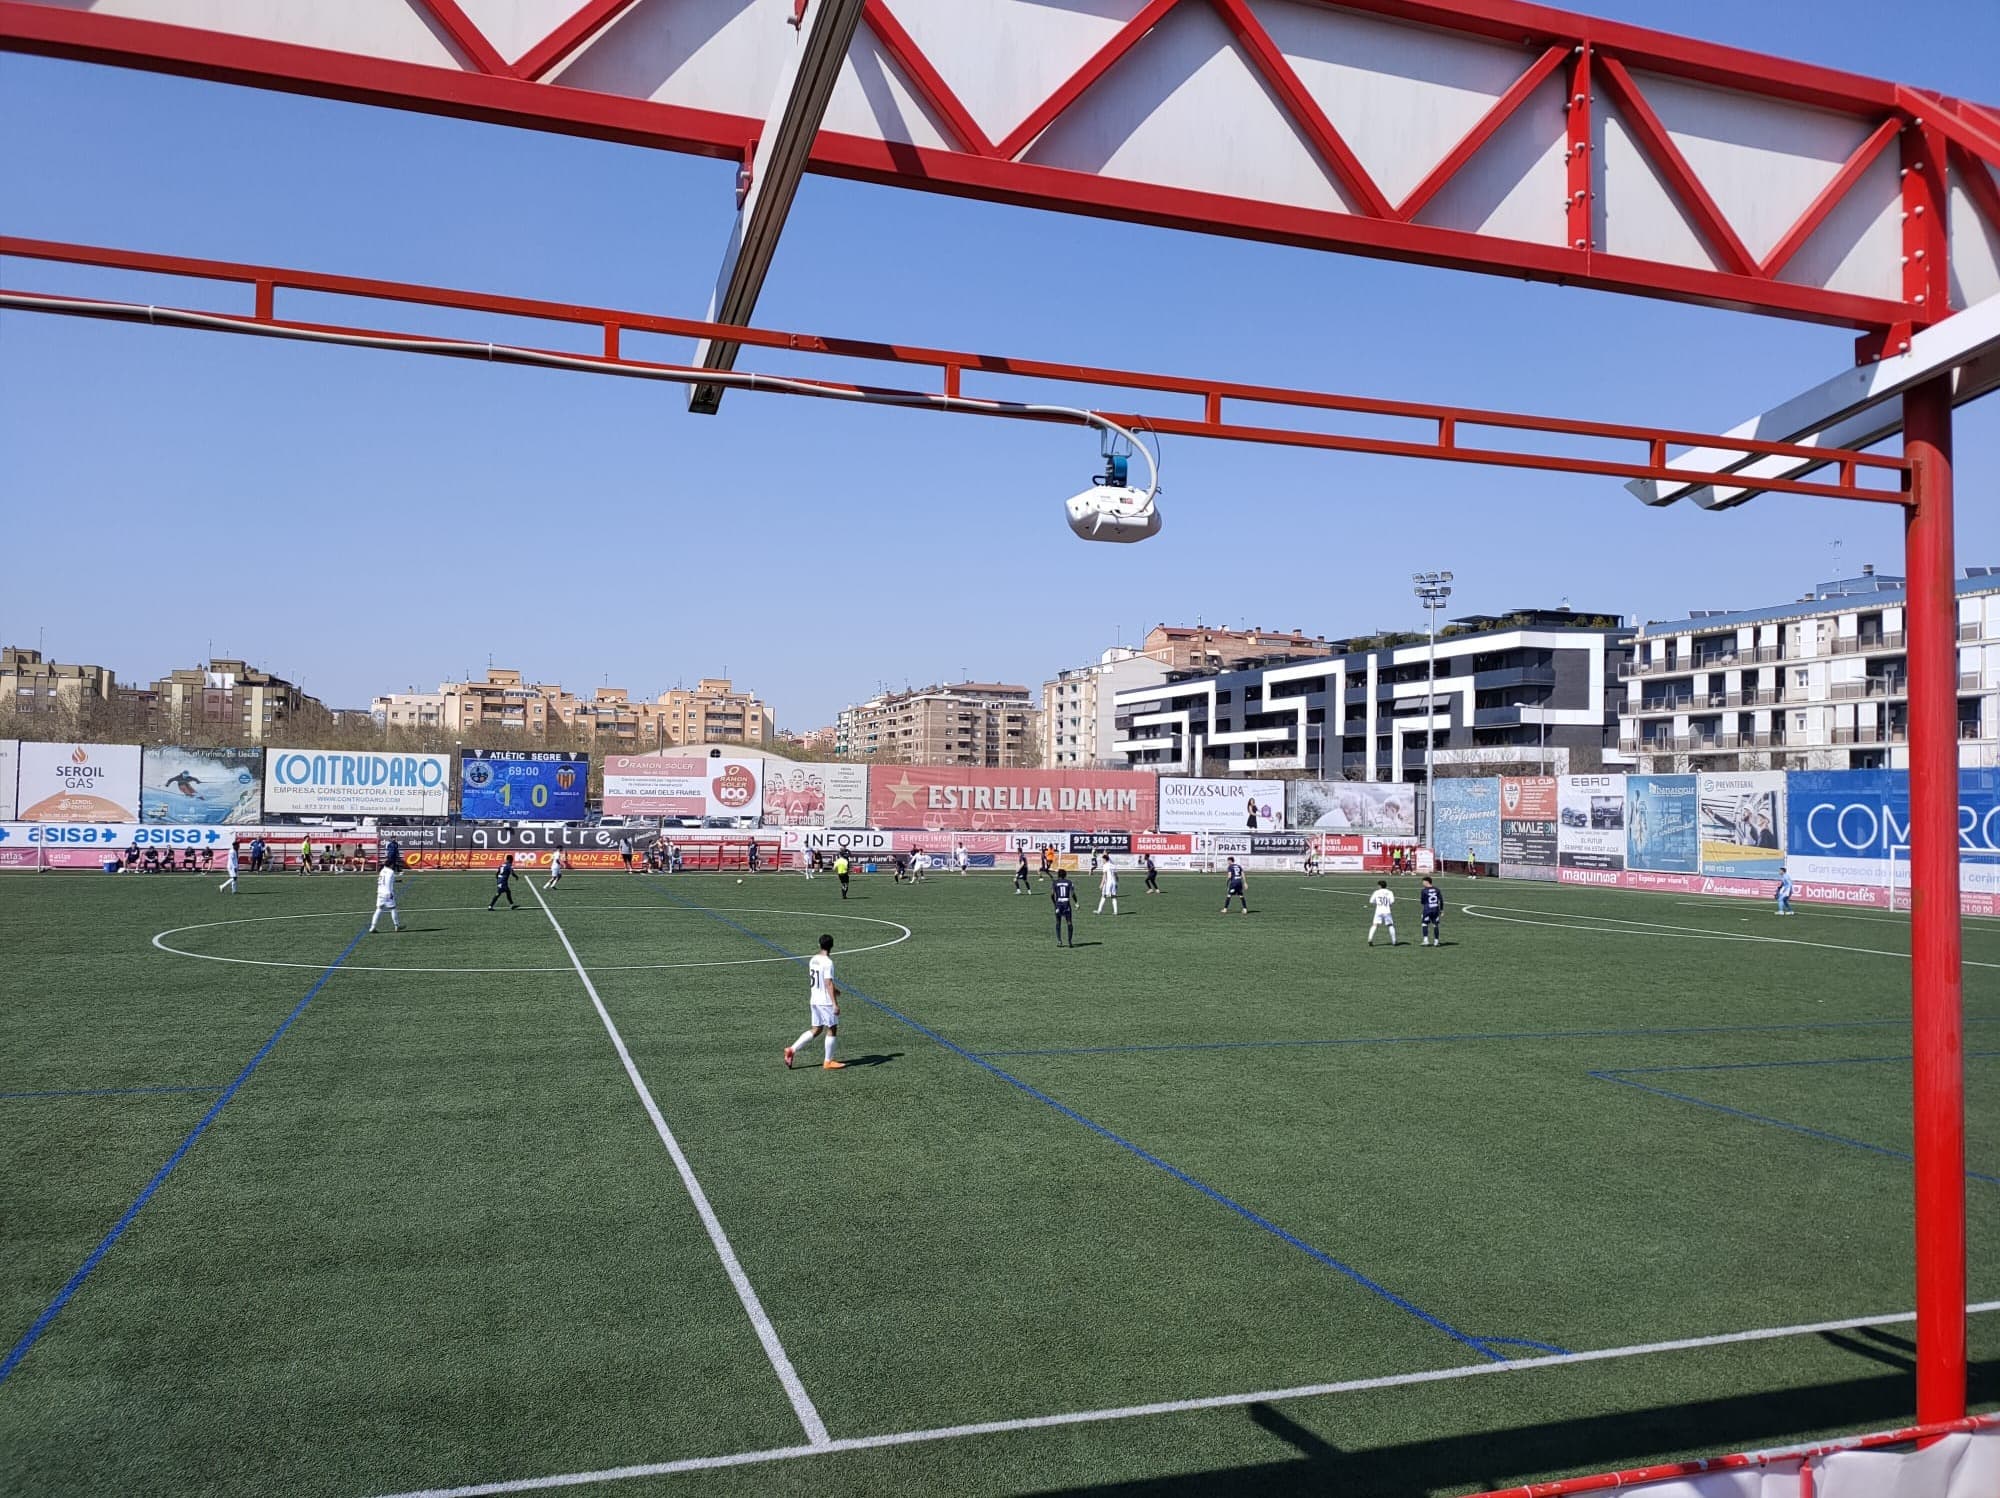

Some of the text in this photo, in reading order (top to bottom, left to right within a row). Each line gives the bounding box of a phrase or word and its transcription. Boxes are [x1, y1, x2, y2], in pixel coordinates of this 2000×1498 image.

[490, 751, 562, 761] ATLÈTIC SEGRE
[56, 766, 104, 777] SEROIL
[275, 754, 442, 788] CONTRUDARO
[508, 766, 539, 776] 69:00
[65, 778, 94, 789] GAS
[317, 787, 387, 795] CONSTRUCTORA
[407, 789, 442, 797] SERVEIS
[500, 784, 511, 807] 1
[532, 784, 548, 808] 0
[720, 788, 747, 799] 100
[928, 785, 1136, 811] ESTRELLA DAMM
[28, 827, 98, 843] asisa
[134, 828, 201, 844] asisa
[805, 833, 884, 848] INFOPID
[1073, 836, 1090, 844] 973
[1092, 836, 1109, 844] 300
[1218, 844, 1247, 852] PRATS
[424, 853, 468, 861] RAMON
[514, 852, 537, 861] 100
[602, 854, 639, 862] SOLR
[1806, 886, 1845, 899] batalla
[1846, 889, 1876, 902] cafés
